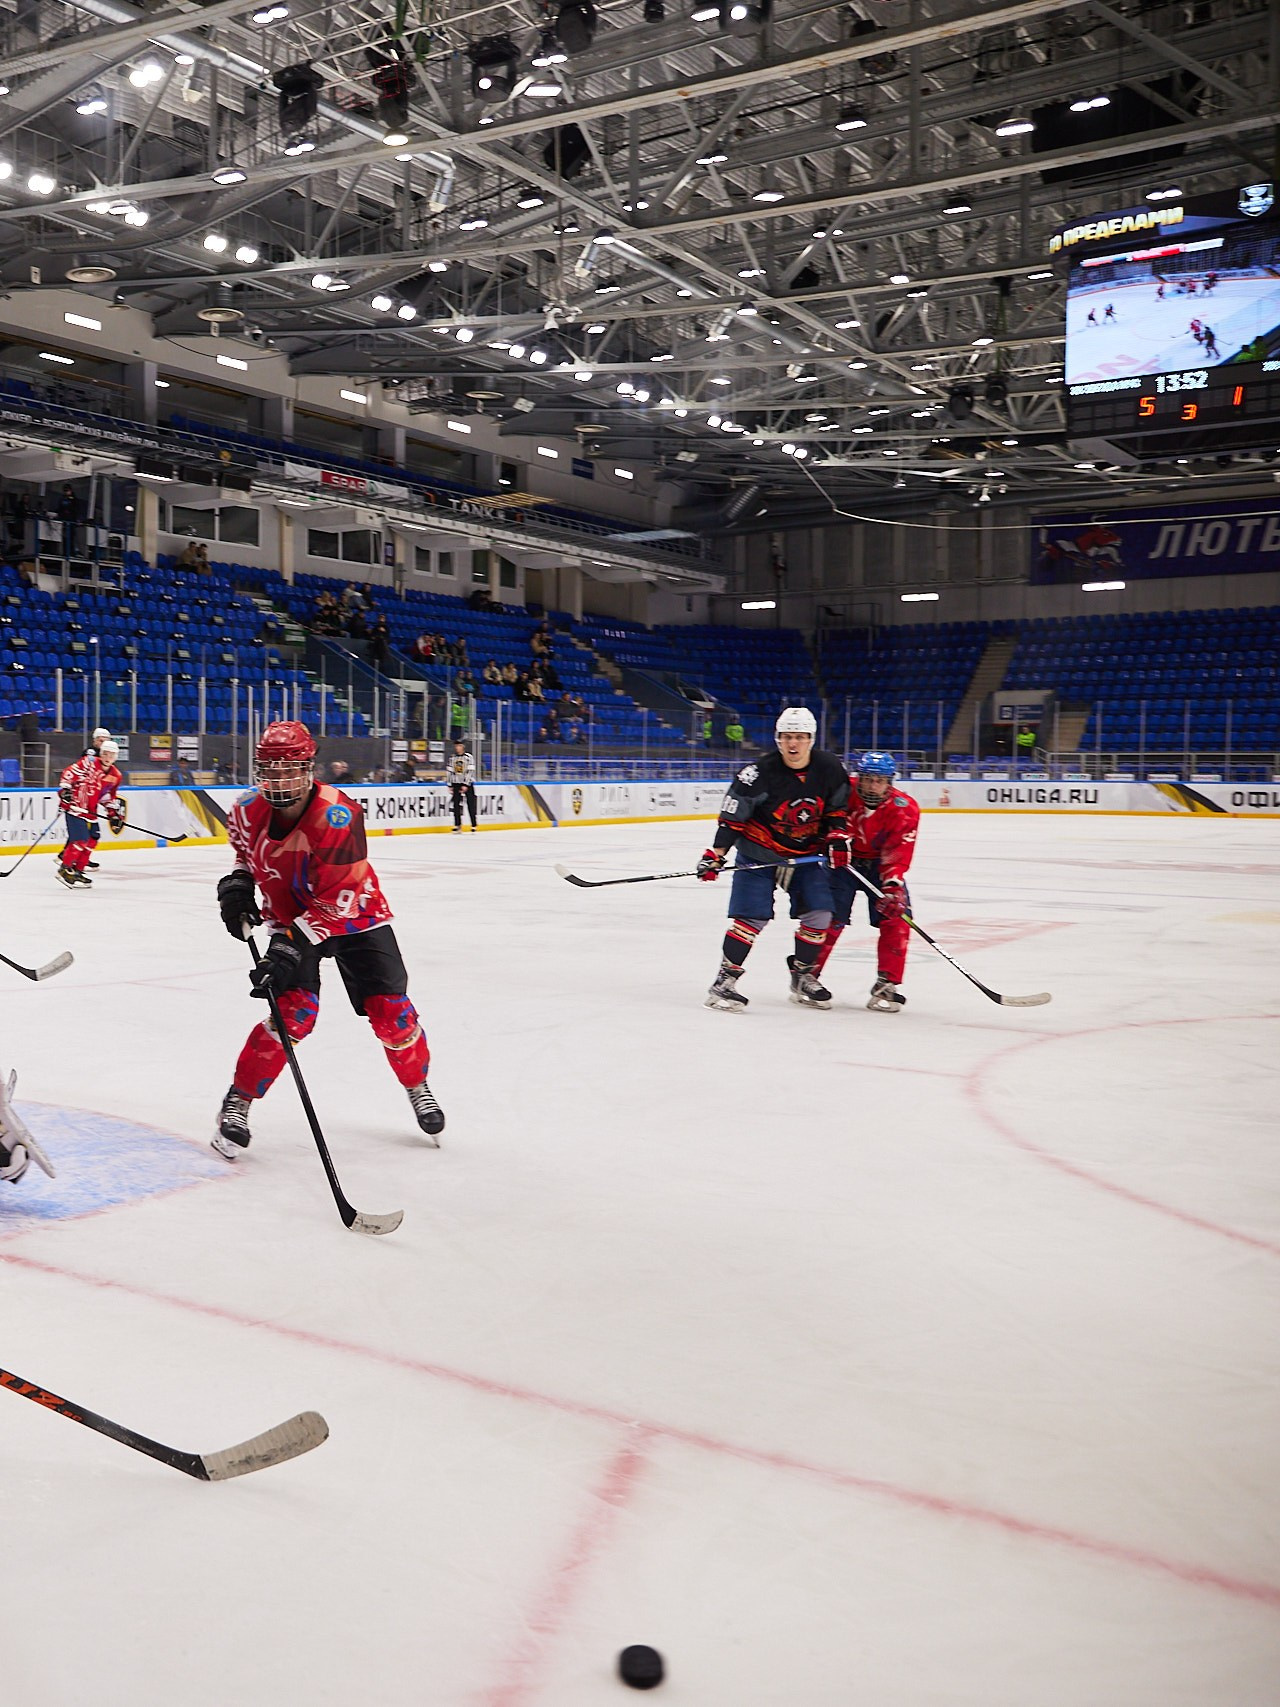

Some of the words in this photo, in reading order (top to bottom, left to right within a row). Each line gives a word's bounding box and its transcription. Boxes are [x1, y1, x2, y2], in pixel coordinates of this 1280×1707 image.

[1139, 396, 1156, 417] 5
[1181, 404, 1199, 421] 3
[987, 787, 1099, 804] OHLIGA.RU
